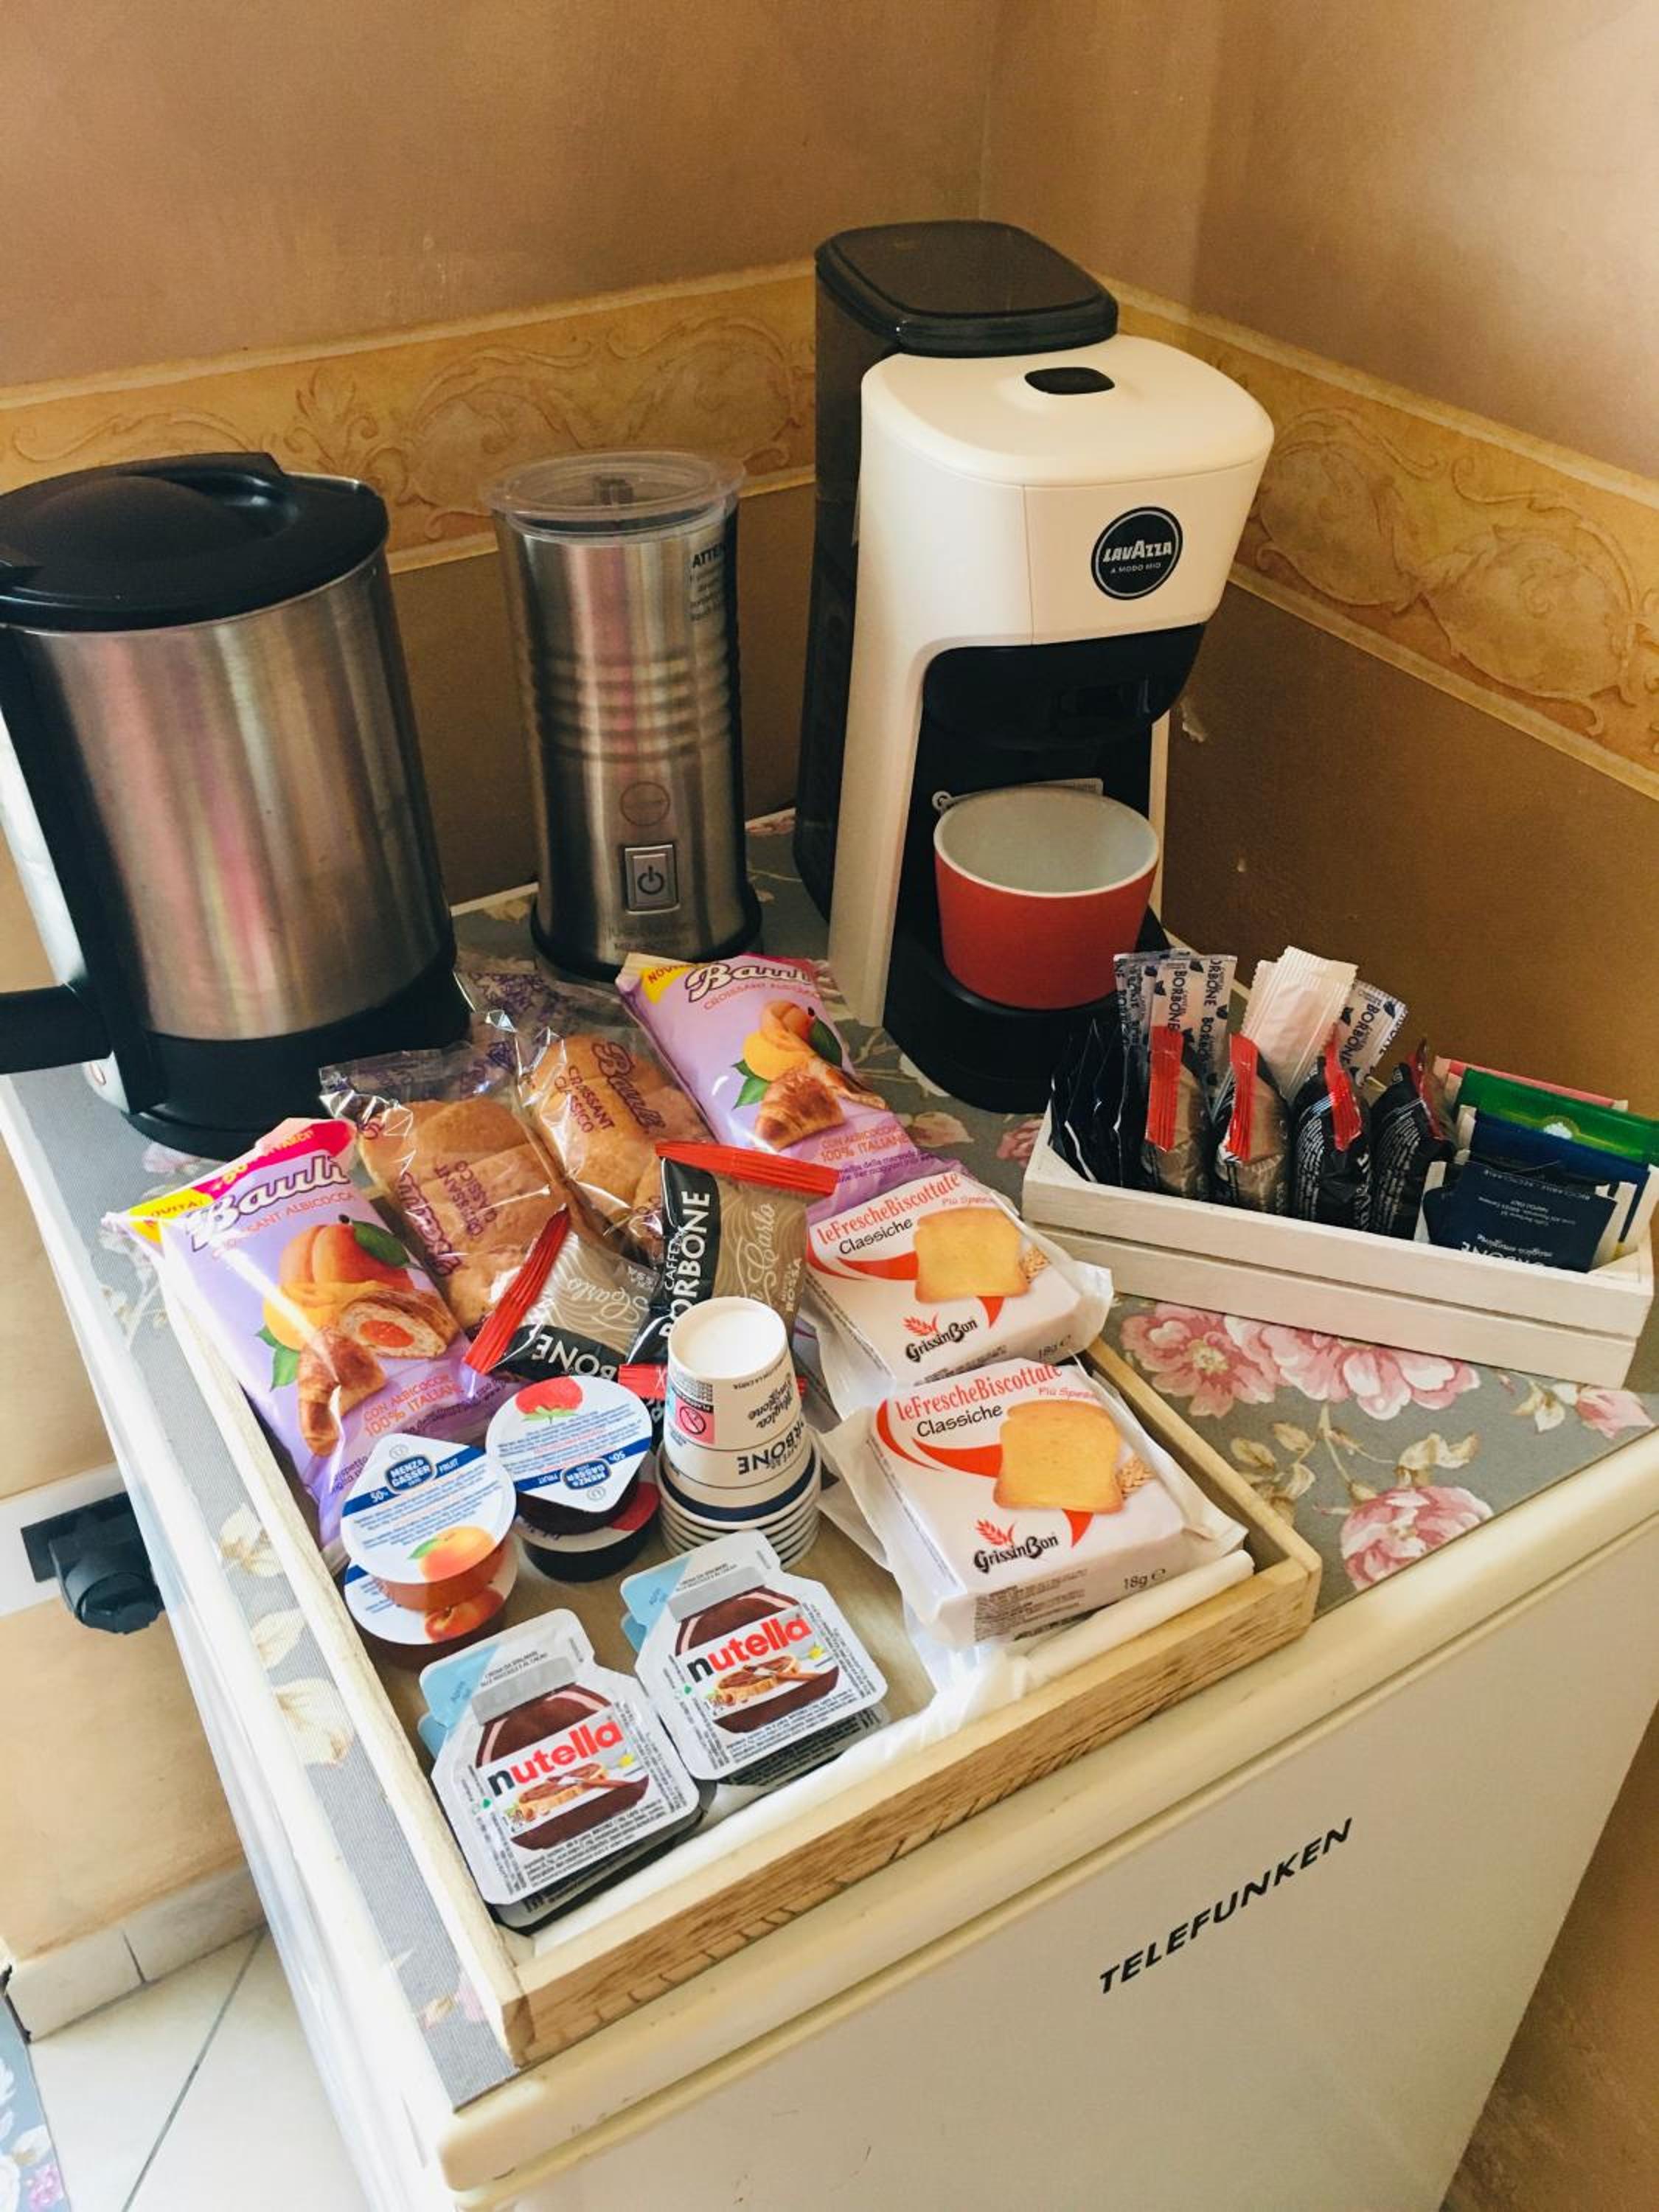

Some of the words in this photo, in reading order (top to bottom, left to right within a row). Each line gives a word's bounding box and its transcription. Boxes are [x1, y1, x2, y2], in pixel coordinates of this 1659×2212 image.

[1102, 540, 1172, 563] LAVAZZA
[1119, 563, 1144, 573] MODO
[684, 962, 811, 1003] Bauli
[1166, 970, 1188, 1032] BORBONE
[591, 1041, 665, 1135] Bauli
[186, 1155, 351, 1252] Bauli
[817, 1172, 961, 1245] leFrescheBiscottate
[838, 1217, 913, 1255] Classiche
[530, 1335, 618, 1380] BONE
[905, 1318, 978, 1363] GrissinBon
[896, 1363, 1063, 1422] leFrescheBiscottate
[917, 1405, 1004, 1438] Classiche
[438, 1458, 459, 1473] FRUIT
[737, 1419, 804, 1475] RBONE
[391, 1464, 431, 1487] GASSER
[973, 1531, 1059, 1573] GrissinBon
[1122, 1572, 1149, 1590] 18g
[687, 1615, 811, 1683] nutella
[487, 1719, 624, 1797] nutella
[1099, 1818, 1352, 1994] TELEFUNKEN
